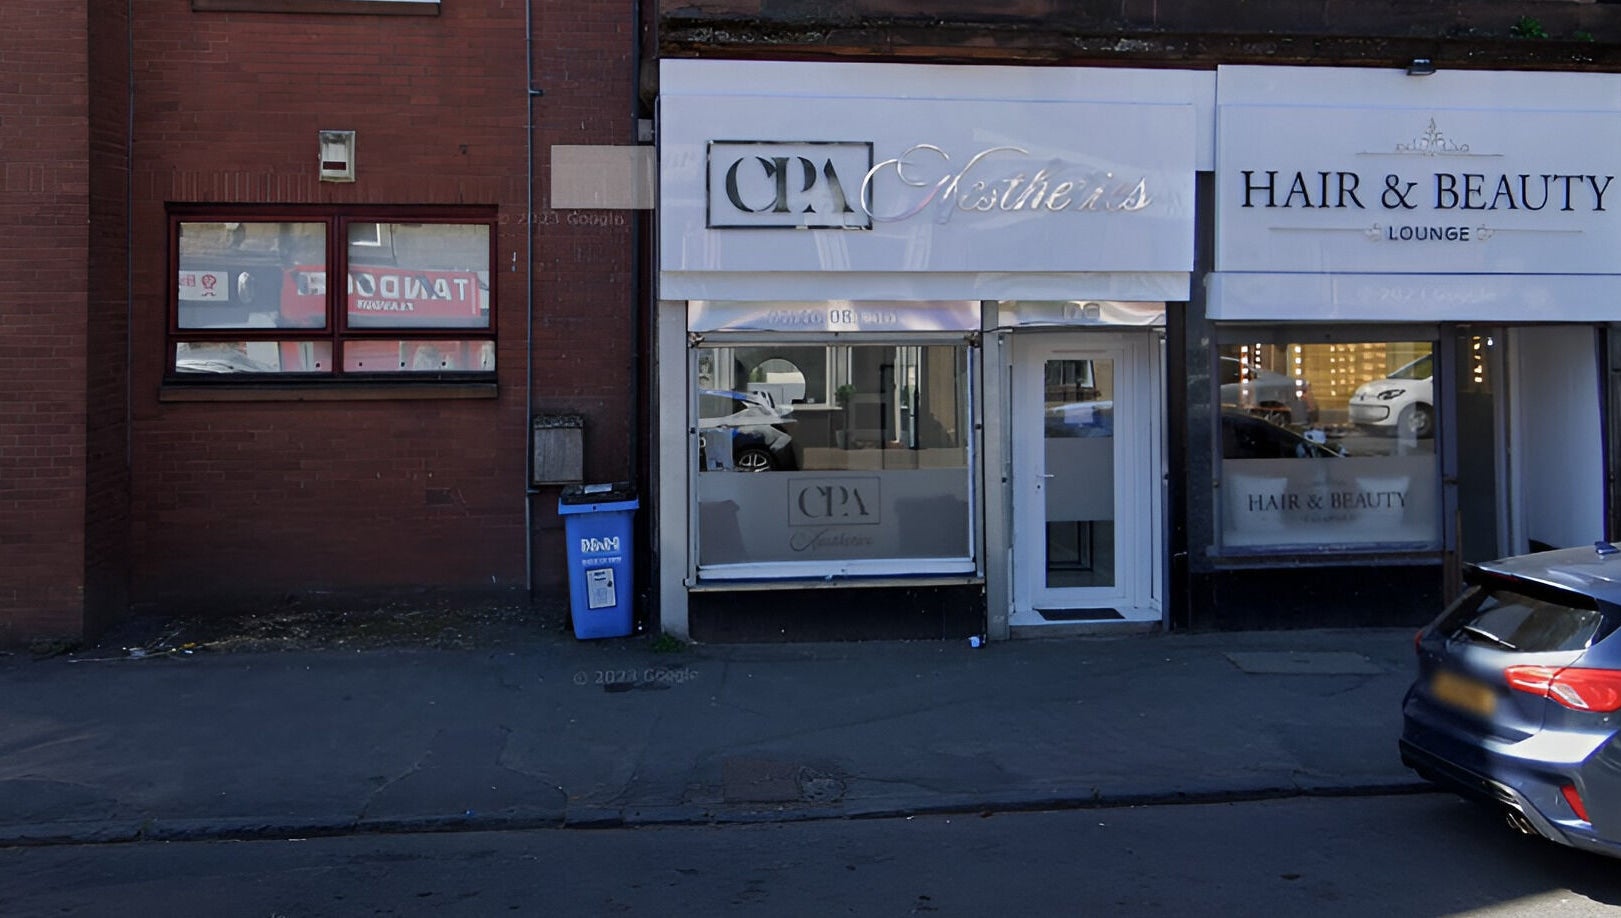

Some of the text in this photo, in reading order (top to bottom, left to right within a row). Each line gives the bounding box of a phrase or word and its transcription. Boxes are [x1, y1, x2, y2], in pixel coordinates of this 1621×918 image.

[725, 155, 855, 213] CPA
[1240, 170, 1615, 212] HAIR & BEAUTY
[1388, 225, 1471, 242] LOUNGE
[798, 485, 870, 519] CPA
[1248, 491, 1409, 512] HAIR & BEAUTY
